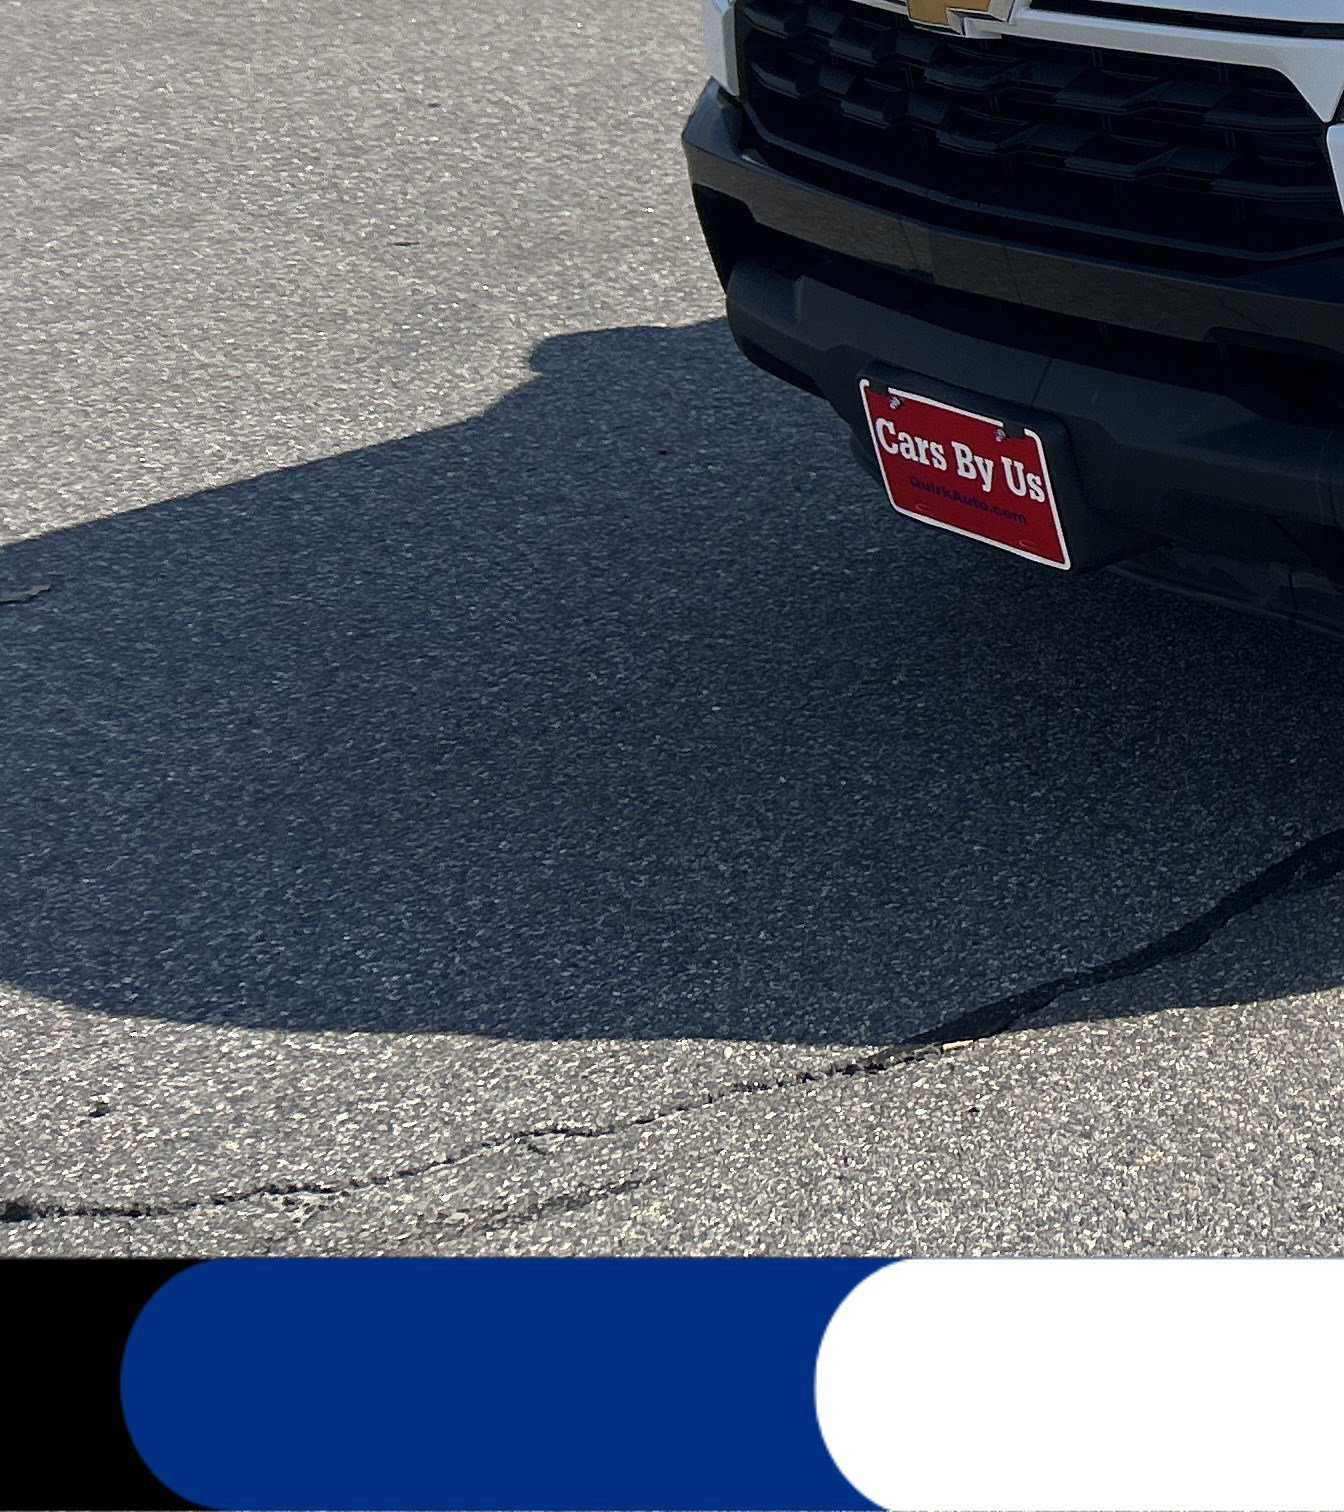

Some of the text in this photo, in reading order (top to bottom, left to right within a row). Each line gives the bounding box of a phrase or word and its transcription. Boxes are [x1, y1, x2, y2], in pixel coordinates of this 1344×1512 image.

[875, 417, 1045, 503] Cars By Us
